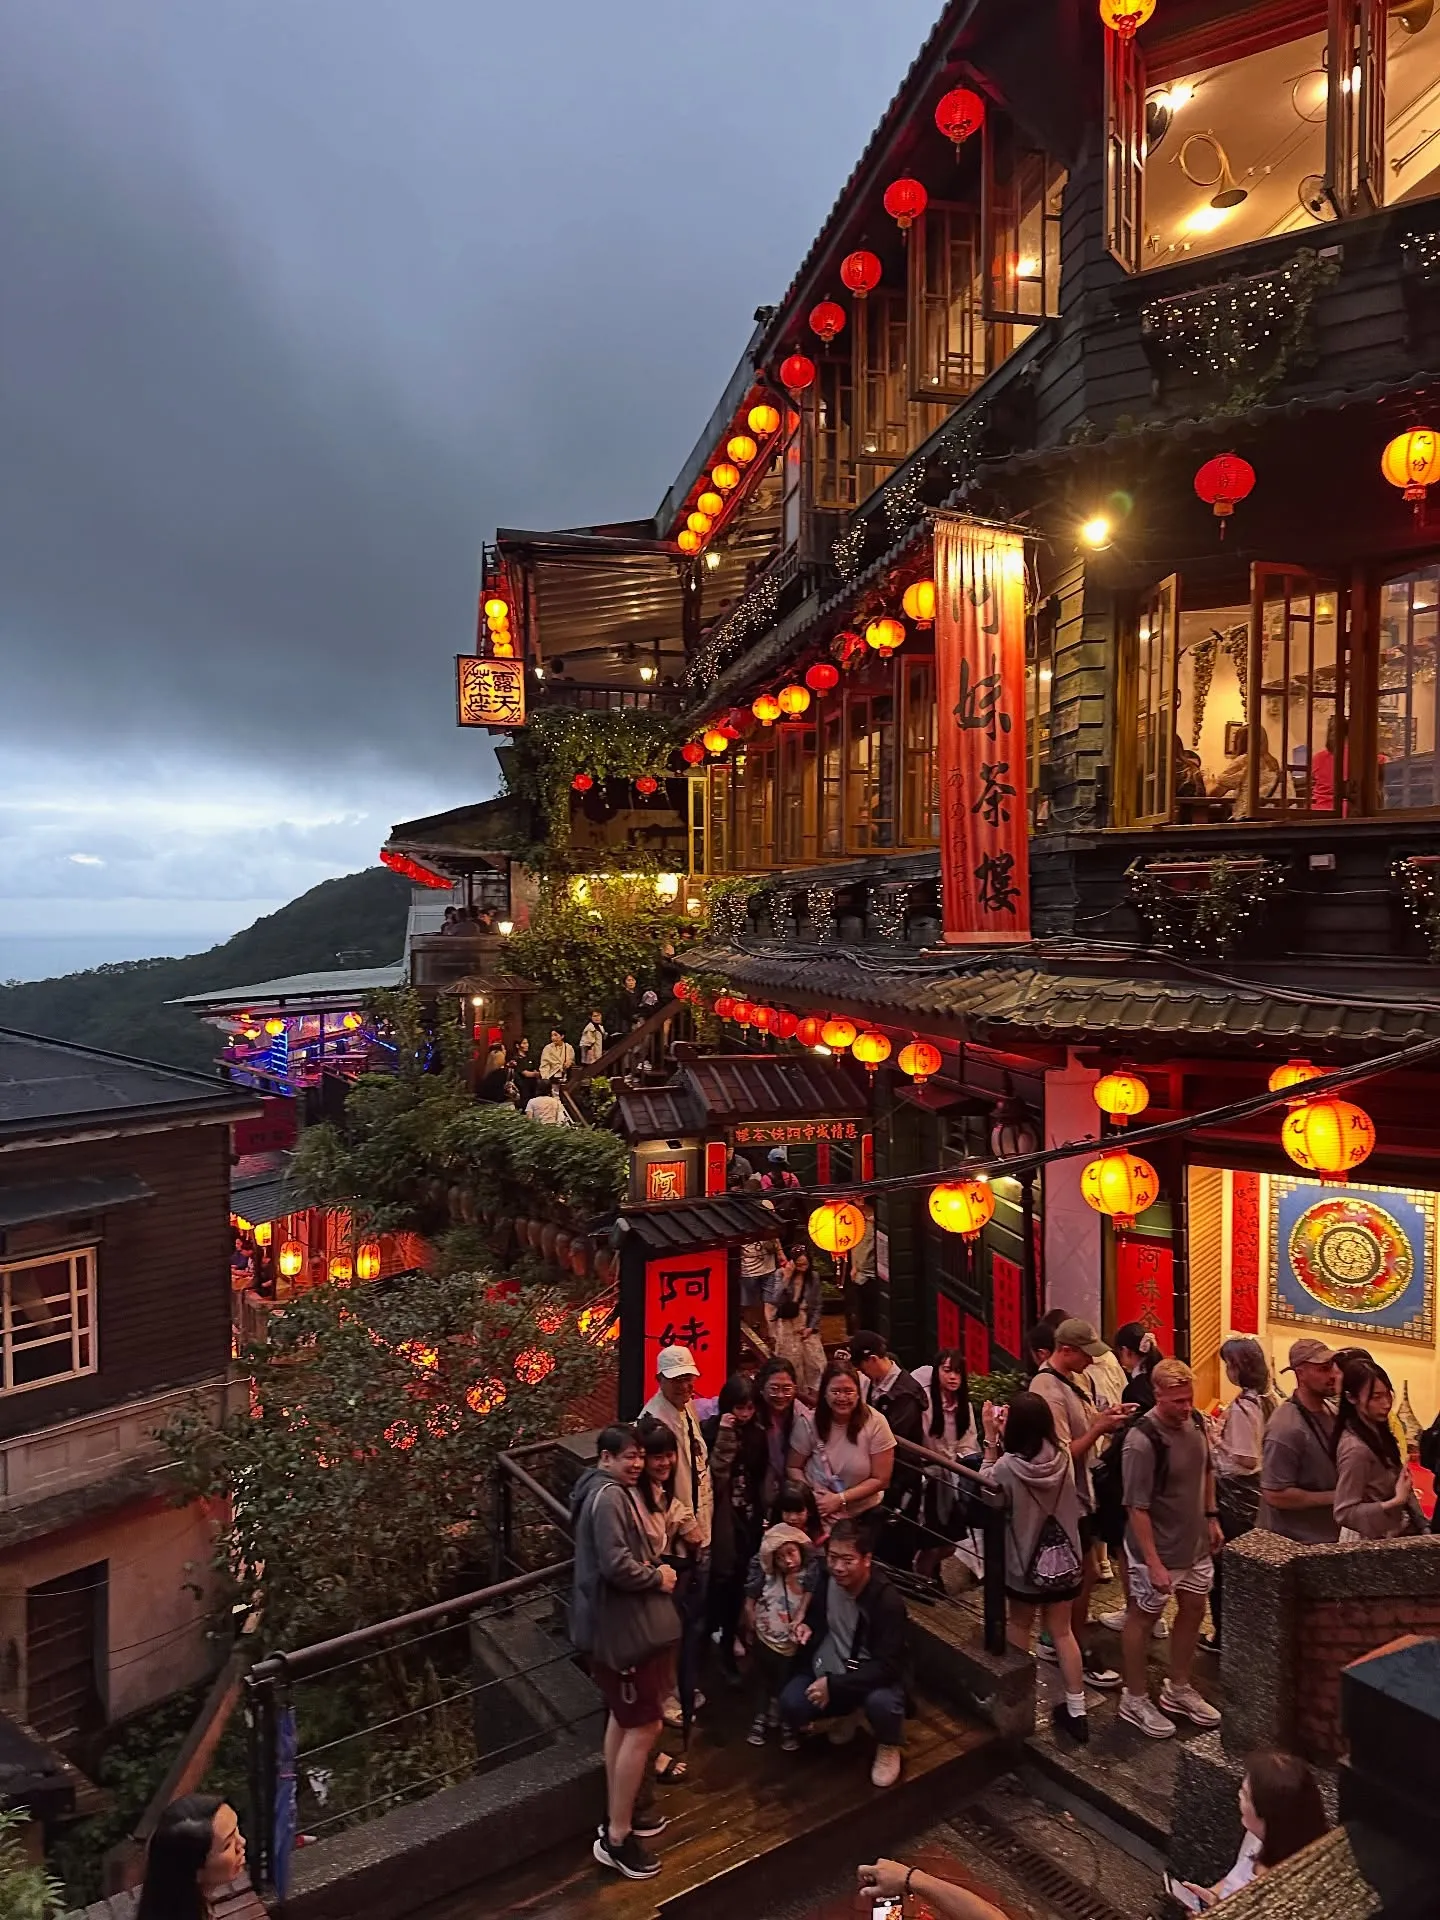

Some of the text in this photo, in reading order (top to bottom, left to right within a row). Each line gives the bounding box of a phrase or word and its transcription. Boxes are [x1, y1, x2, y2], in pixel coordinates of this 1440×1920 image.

[1412, 435, 1432, 472] 九份
[1350, 1114, 1370, 1162] 九份
[1133, 1165, 1151, 1206] 九份
[839, 1214, 853, 1247] 九份
[658, 1266, 712, 1351] 阿妹
